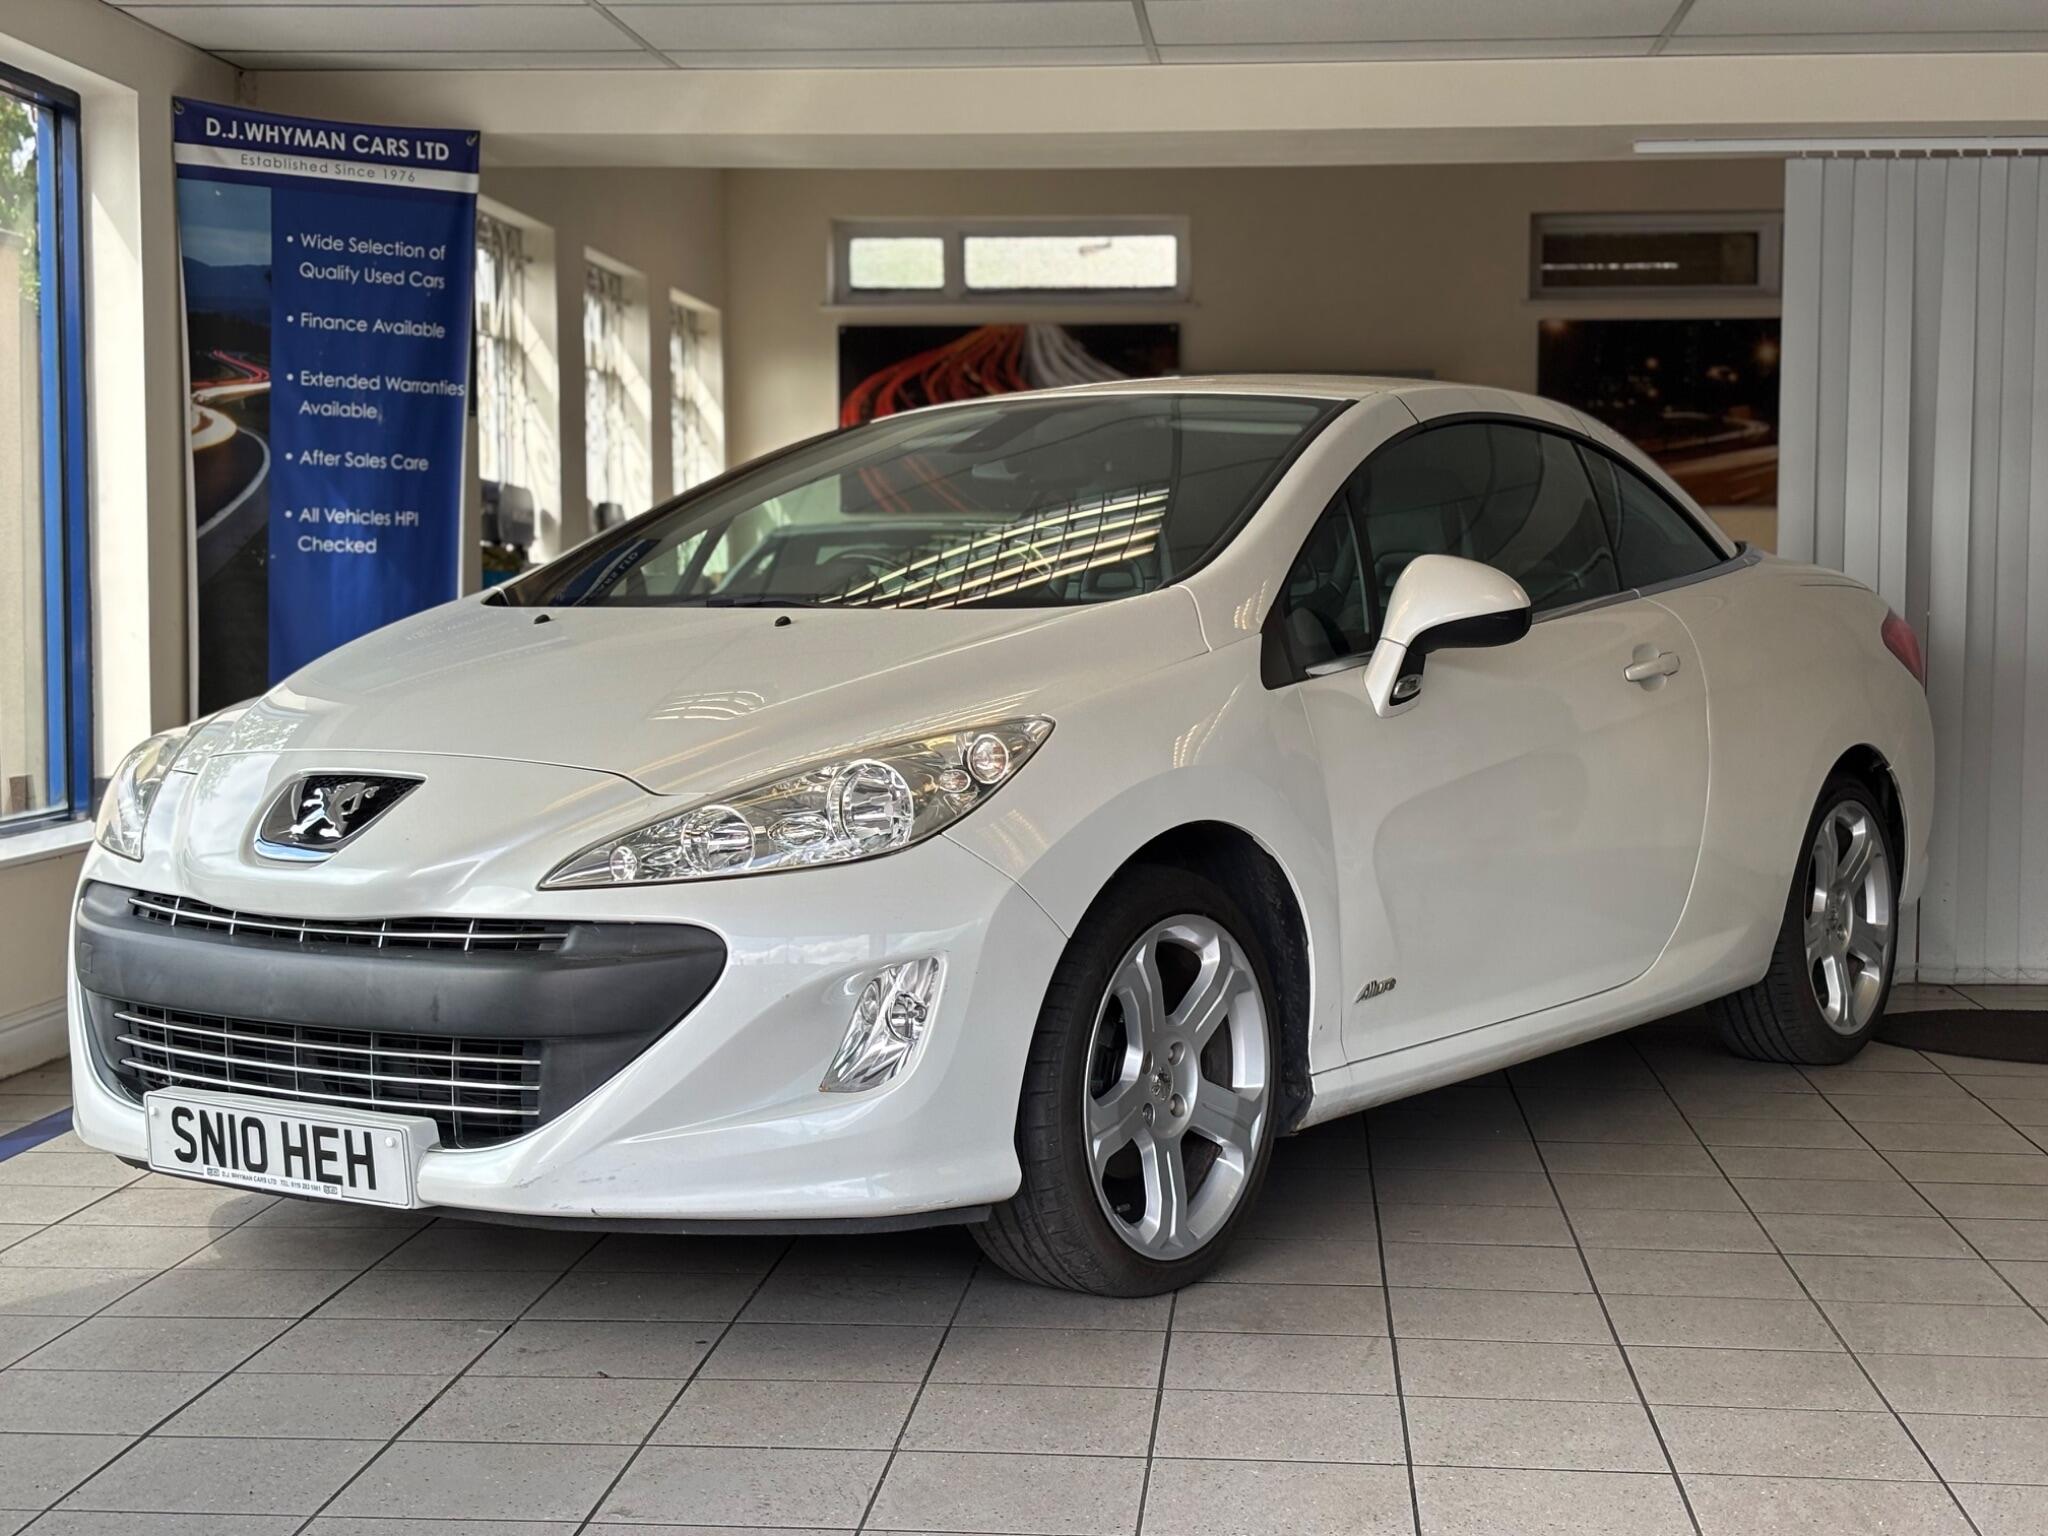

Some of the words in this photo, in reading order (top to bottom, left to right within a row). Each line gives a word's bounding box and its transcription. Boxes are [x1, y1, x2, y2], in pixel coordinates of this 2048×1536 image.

[205, 117, 346, 151] D.J.WHYMAN
[352, 134, 410, 158] CARS
[416, 140, 450, 162] LTD
[240, 153, 329, 175] Established
[335, 159, 376, 178] Since
[382, 167, 417, 183] 1976
[300, 233, 344, 251] Wide
[348, 237, 425, 258] Selection
[429, 244, 447, 261] of
[299, 261, 360, 285] Quality
[364, 267, 405, 285] Used
[409, 271, 446, 289] Cars
[300, 312, 368, 332] Finance
[372, 318, 446, 339] Available
[300, 370, 381, 391] Extended
[385, 375, 466, 396] Warranties
[299, 400, 378, 419] Available
[300, 449, 341, 467] After
[344, 451, 388, 469] Sales
[391, 454, 430, 471] Care
[299, 507, 320, 523] All
[324, 507, 391, 526] Vehicles
[395, 510, 419, 527] HPI
[297, 535, 378, 554] Checked
[171, 1106, 268, 1174] SN10
[280, 1121, 377, 1190] HEH
